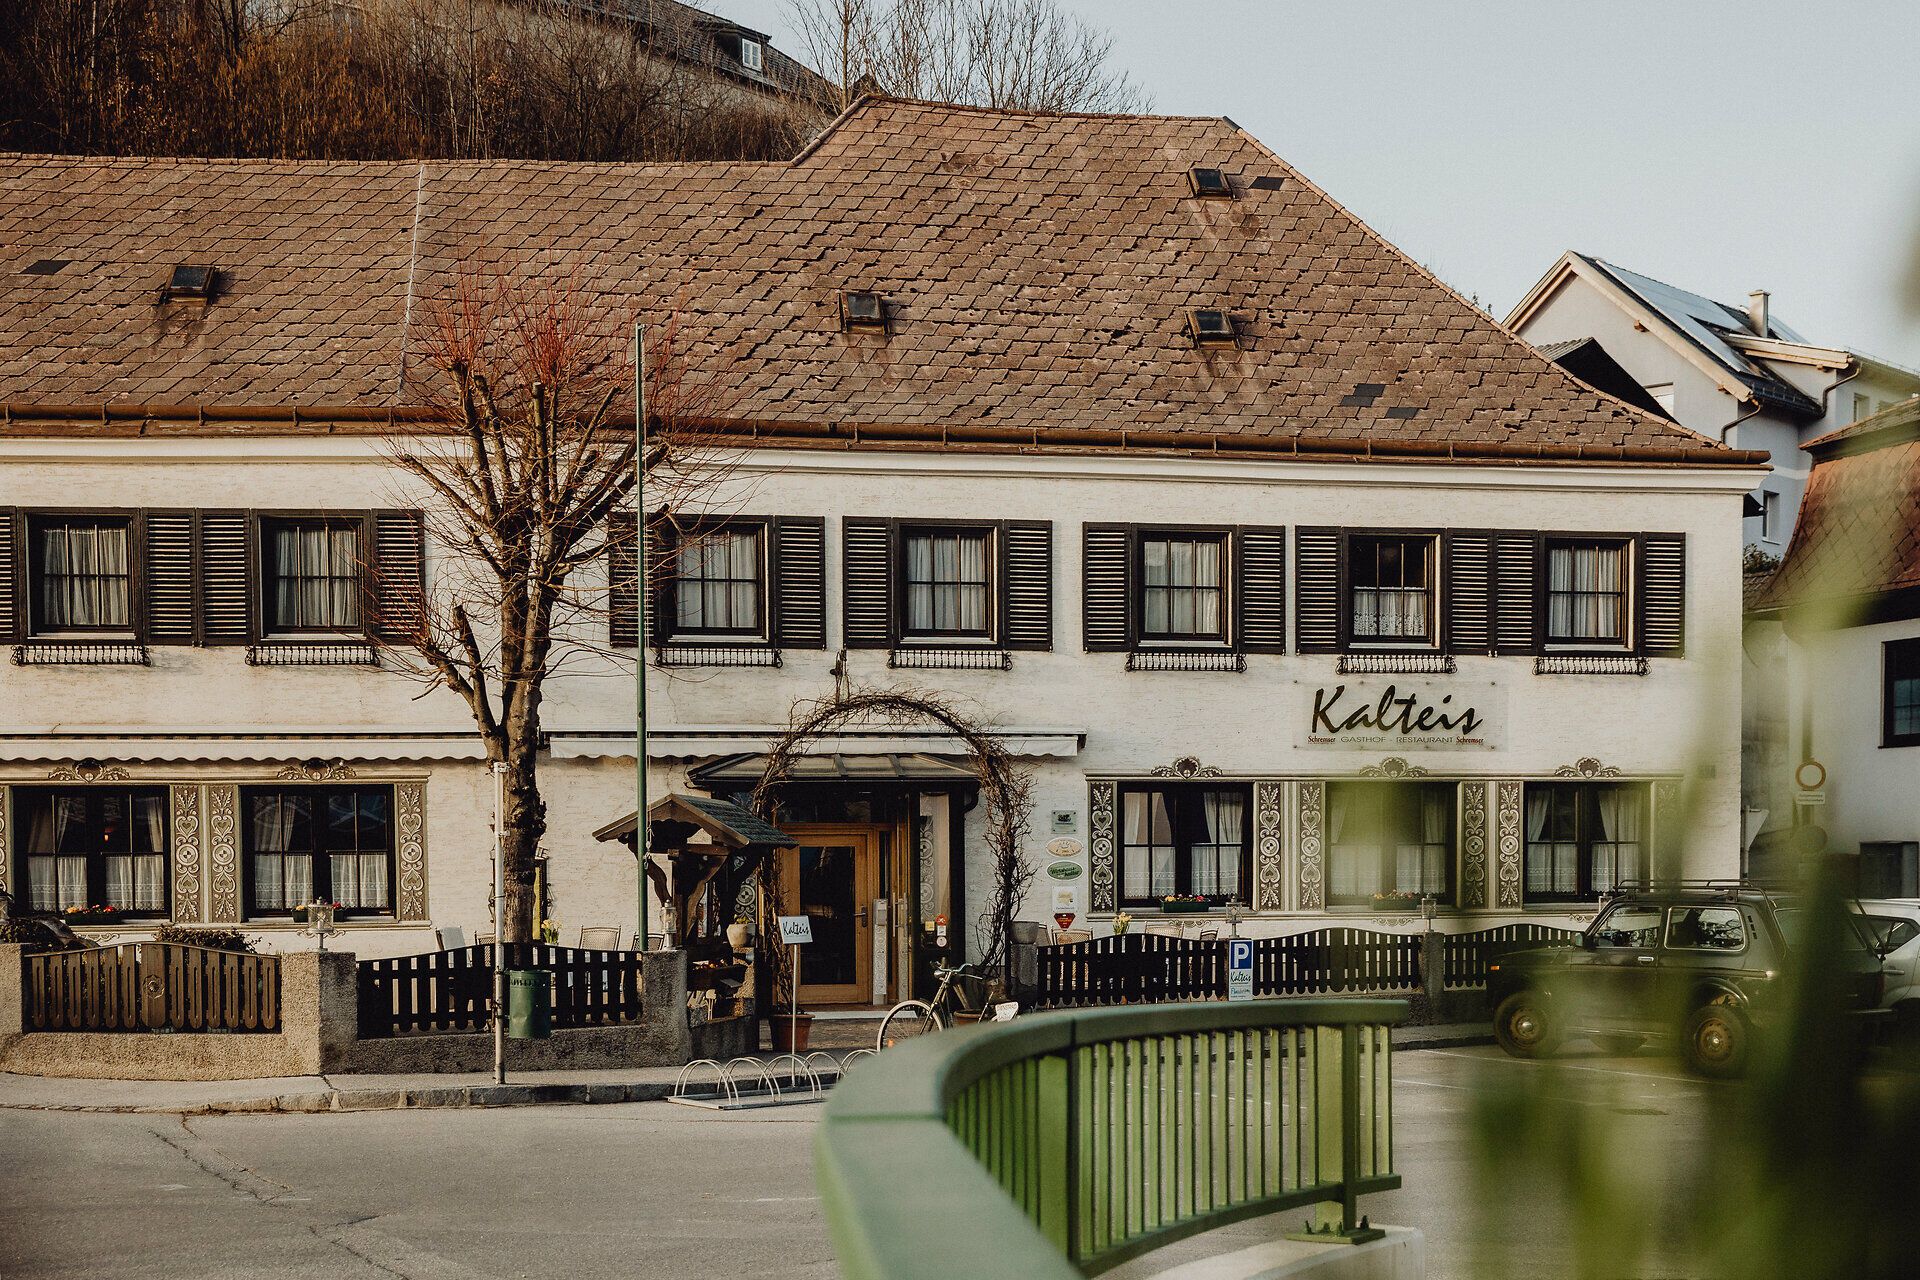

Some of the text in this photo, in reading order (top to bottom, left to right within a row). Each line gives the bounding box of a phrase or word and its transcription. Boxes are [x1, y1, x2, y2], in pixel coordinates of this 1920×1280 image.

[1311, 684, 1483, 735] Kalteis
[782, 921, 810, 935] Kalteis
[1233, 943, 1250, 968] P
